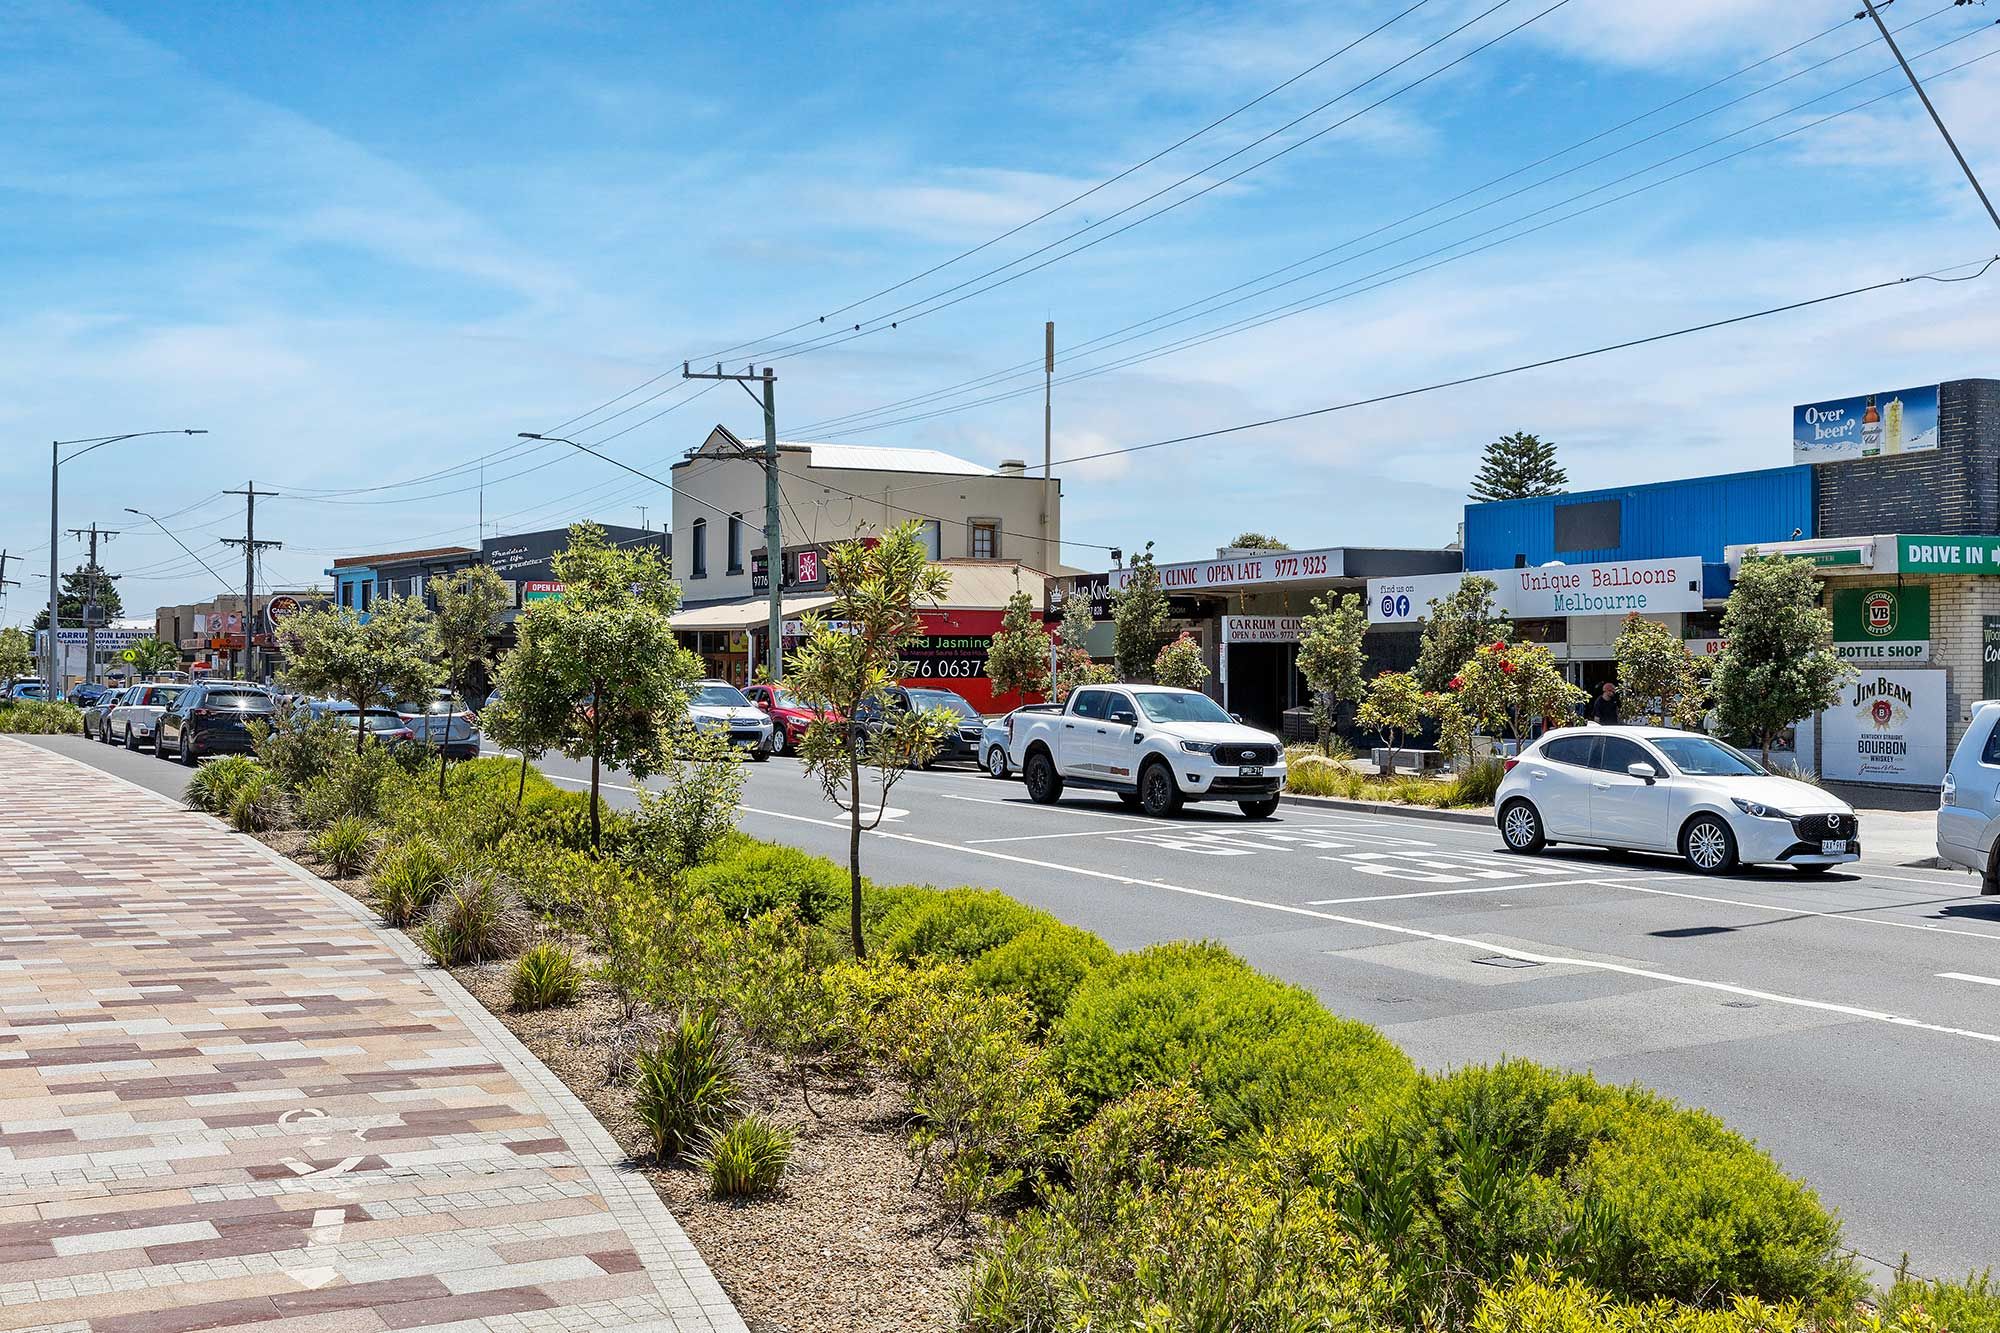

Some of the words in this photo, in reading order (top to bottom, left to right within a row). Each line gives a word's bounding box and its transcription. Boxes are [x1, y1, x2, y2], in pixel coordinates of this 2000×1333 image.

[1805, 407, 1844, 424] Over
[1815, 418, 1856, 440] beer?
[1908, 545, 1960, 564] DRIVE
[1966, 546, 1983, 564] IN
[1165, 567, 1198, 586] CLINIC
[1207, 564, 1234, 582] OPEN
[1238, 562, 1262, 580] LATE
[1275, 558, 1298, 577] 9772
[1303, 556, 1327, 575] 9325
[753, 575, 769, 587] 9776
[1521, 573, 1580, 593] Unique
[1591, 567, 1677, 587] Balloons
[532, 583, 550, 592] OPEN
[552, 583, 567, 592] LAT
[1380, 584, 1395, 593] find
[1554, 593, 1647, 612] Melbourne
[1865, 593, 1893, 604] VICTORIA
[1871, 607, 1889, 620] VB
[1229, 619, 1276, 630] CARRUM
[1280, 619, 1310, 630] CLIN
[1867, 624, 1893, 634] BITTER
[1231, 631, 1249, 639] OPEN
[1251, 631, 1257, 639] 6
[935, 636, 991, 649] Jasmine
[1706, 641, 1718, 654] 03
[1838, 646, 1885, 658] BOTTLE
[1887, 645, 1923, 657] SHOP
[938, 660, 981, 678] 0637
[1853, 682, 1876, 707] JIM
[1877, 677, 1912, 708] BEAM
[1858, 740, 1907, 755] BOURBON
[1870, 755, 1894, 763] WHISKEY
[1105, 829, 1437, 856] CLEAR
